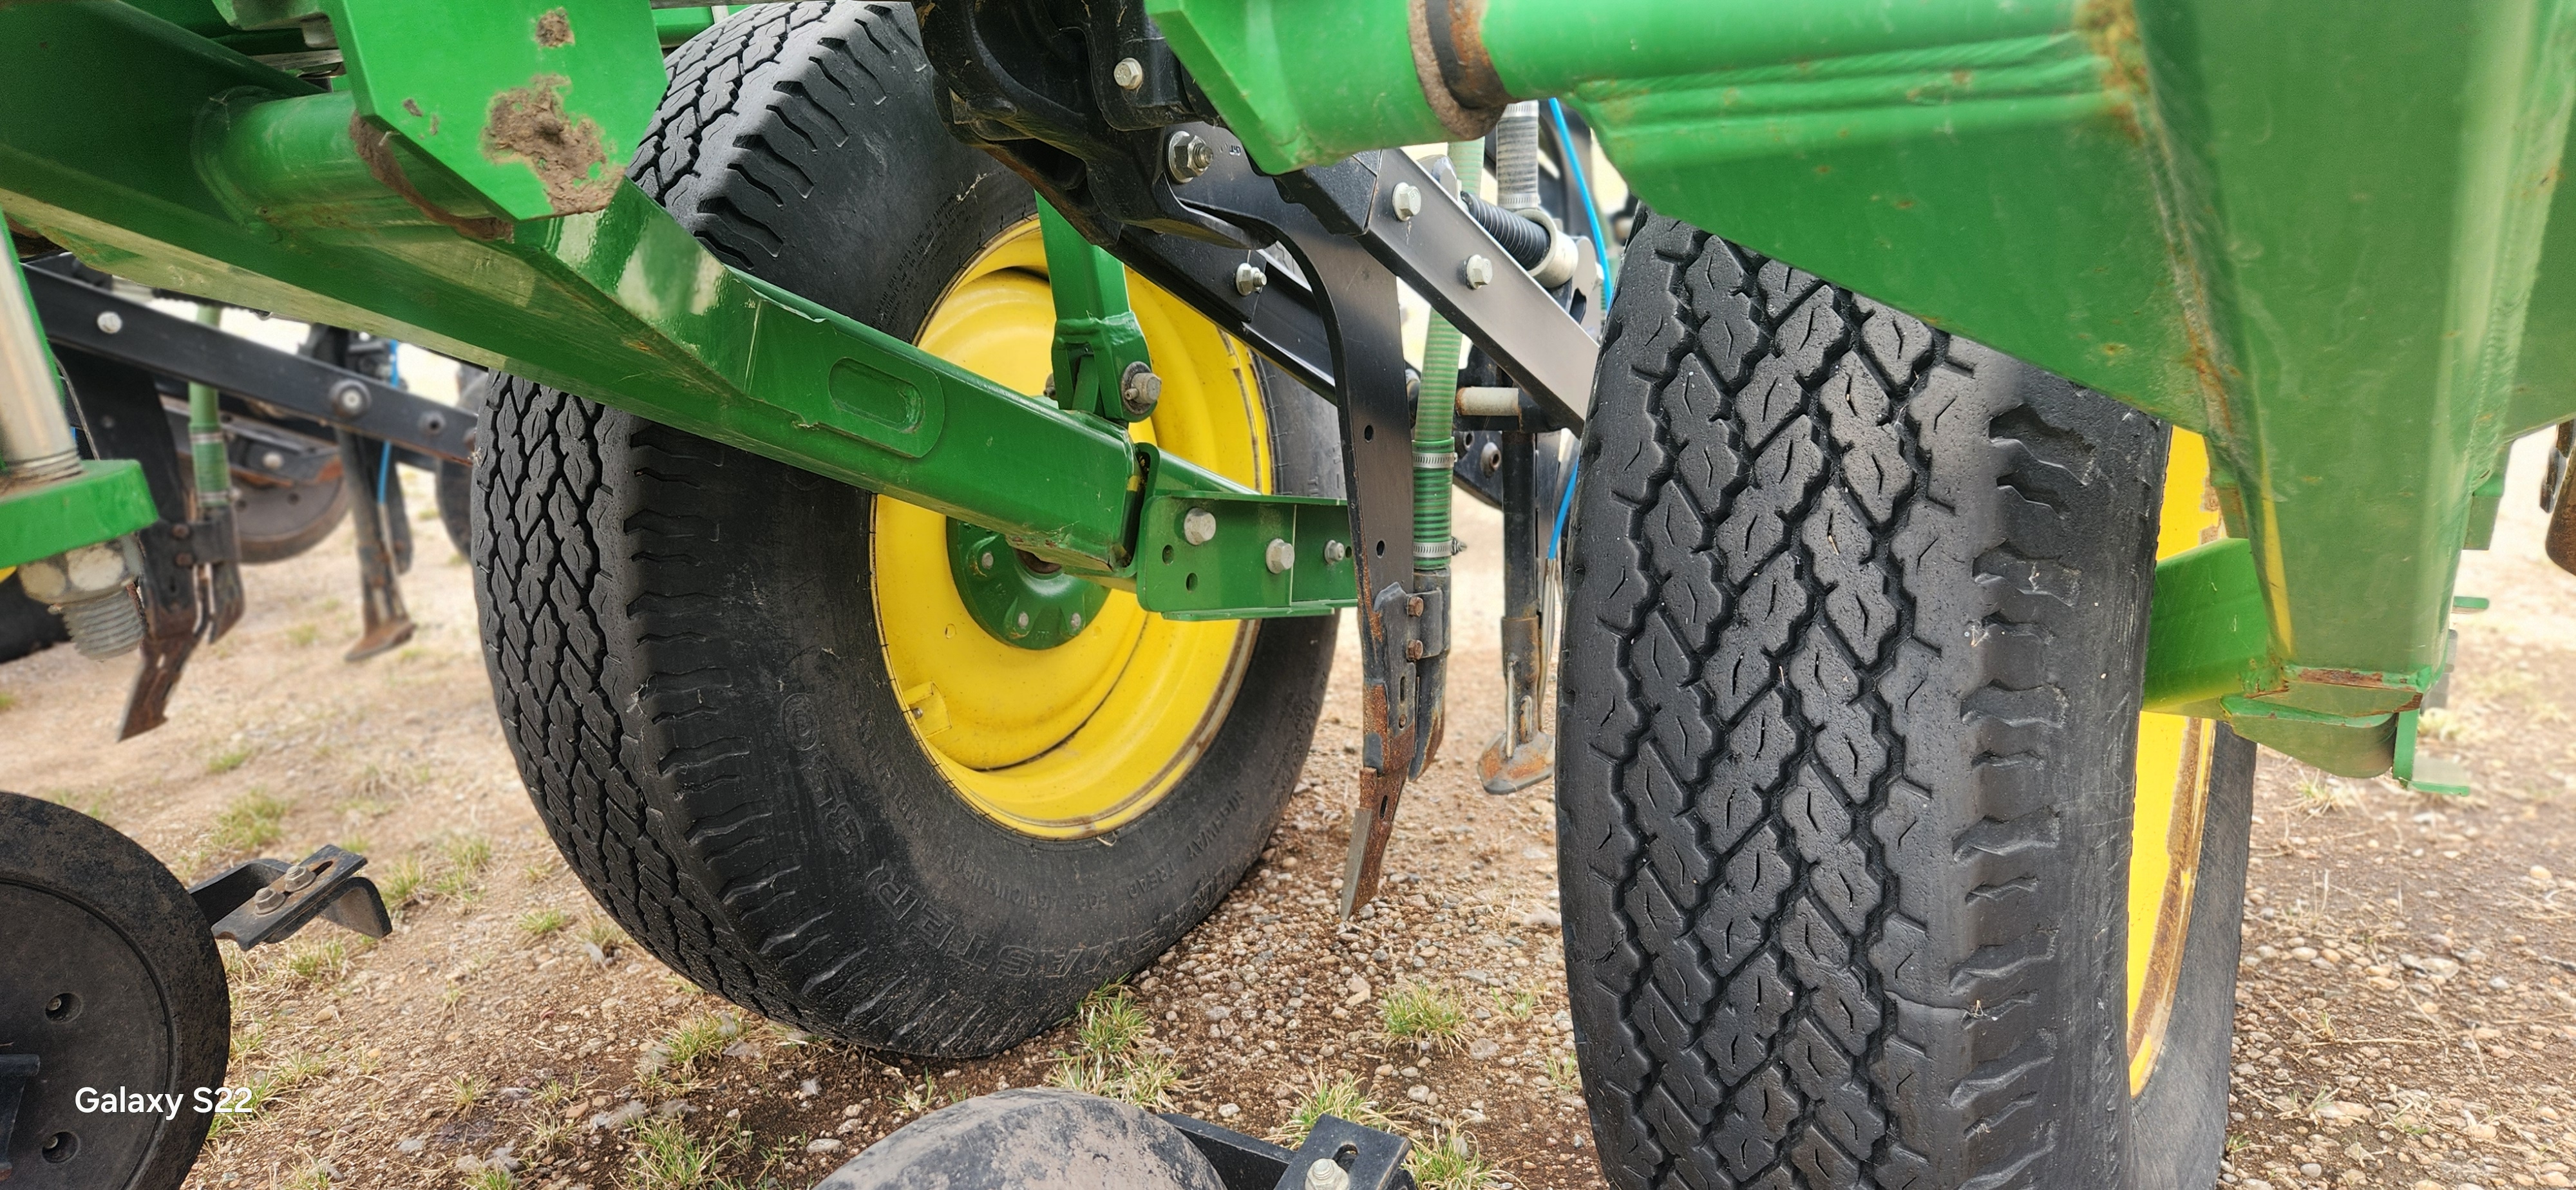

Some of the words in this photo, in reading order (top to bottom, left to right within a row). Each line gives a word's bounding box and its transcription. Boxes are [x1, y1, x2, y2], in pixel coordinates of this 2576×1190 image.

[1184, 790, 1245, 861] HIGHWAY
[942, 846, 1063, 911] AGRICULTURAL
[1078, 890, 1109, 911] FOR
[1127, 861, 1177, 899] TREAD
